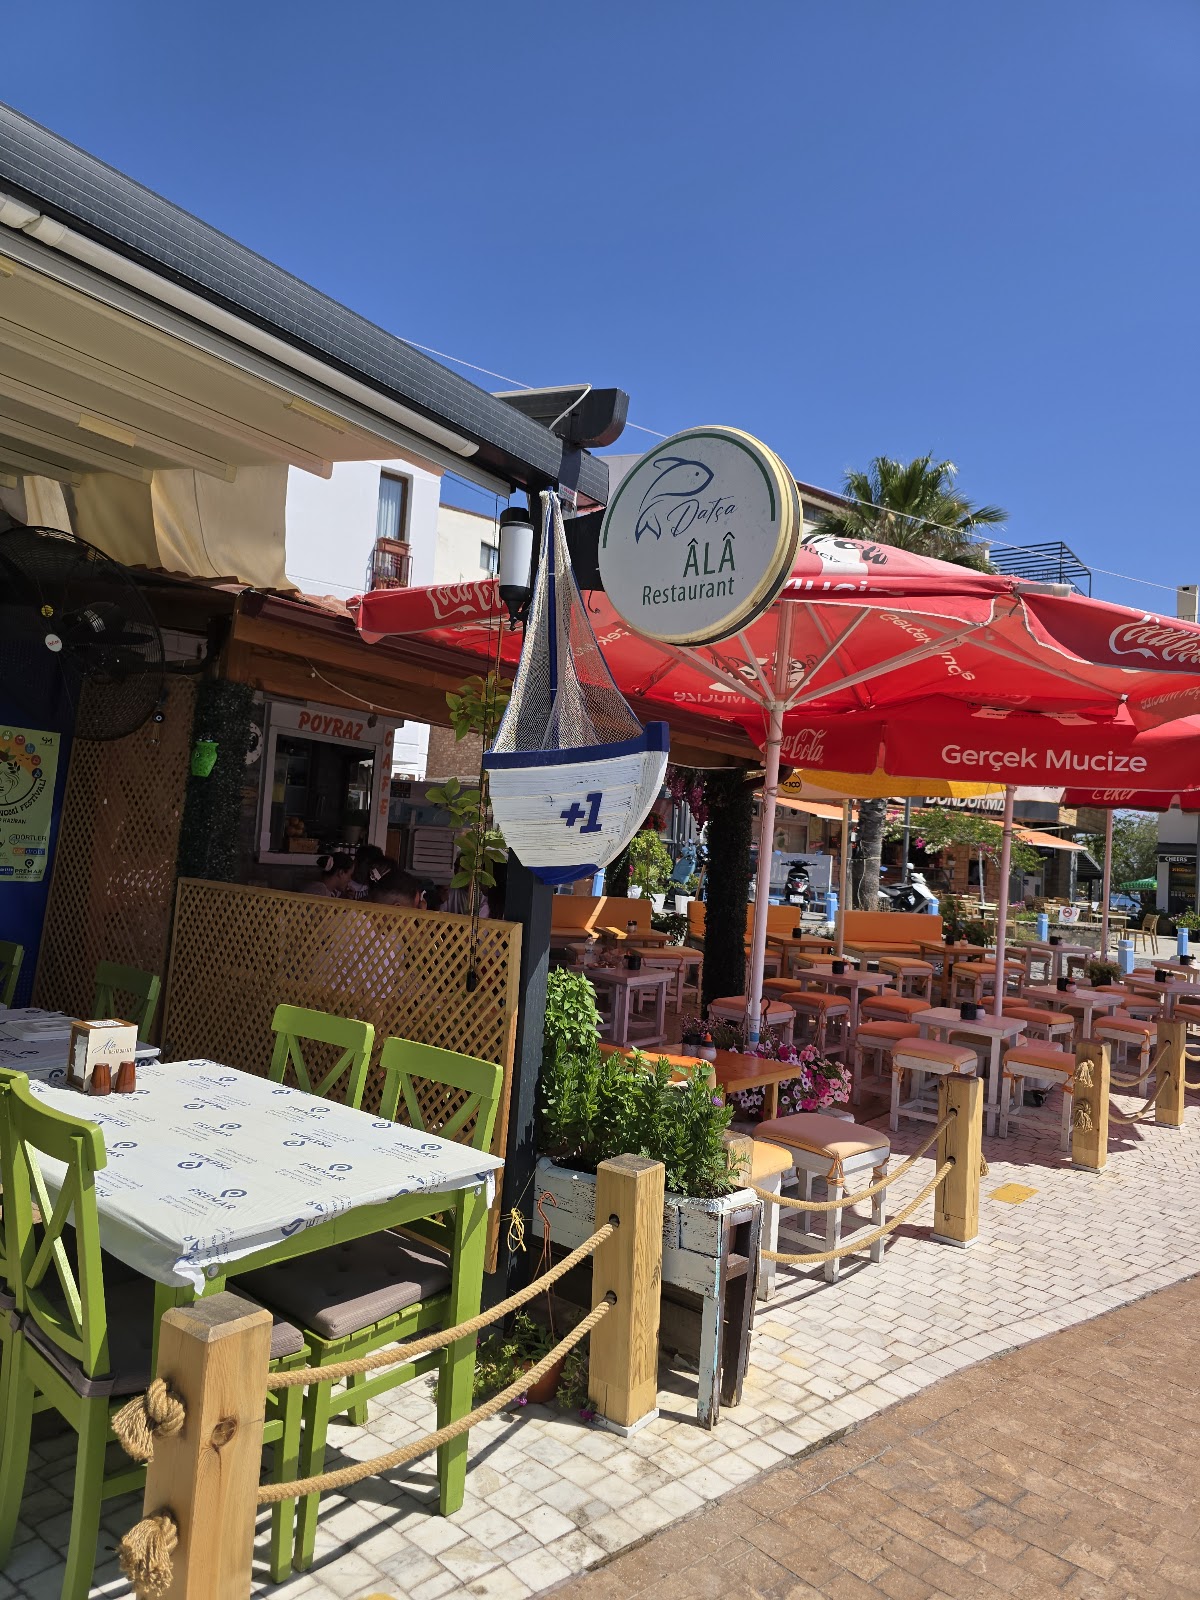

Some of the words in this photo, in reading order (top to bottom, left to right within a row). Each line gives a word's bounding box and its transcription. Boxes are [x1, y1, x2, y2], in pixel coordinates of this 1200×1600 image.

[666, 495, 738, 538] Datça
[682, 531, 736, 578] ÂLÂ
[641, 576, 735, 606] Restaurant
[298, 710, 364, 741] POYRAZ
[378, 730, 394, 816] CAFE
[941, 744, 1038, 772] Gerçek
[1046, 748, 1148, 773] Mucize
[560, 792, 603, 834] +1
[187, 1187, 237, 1210] PREMAR
